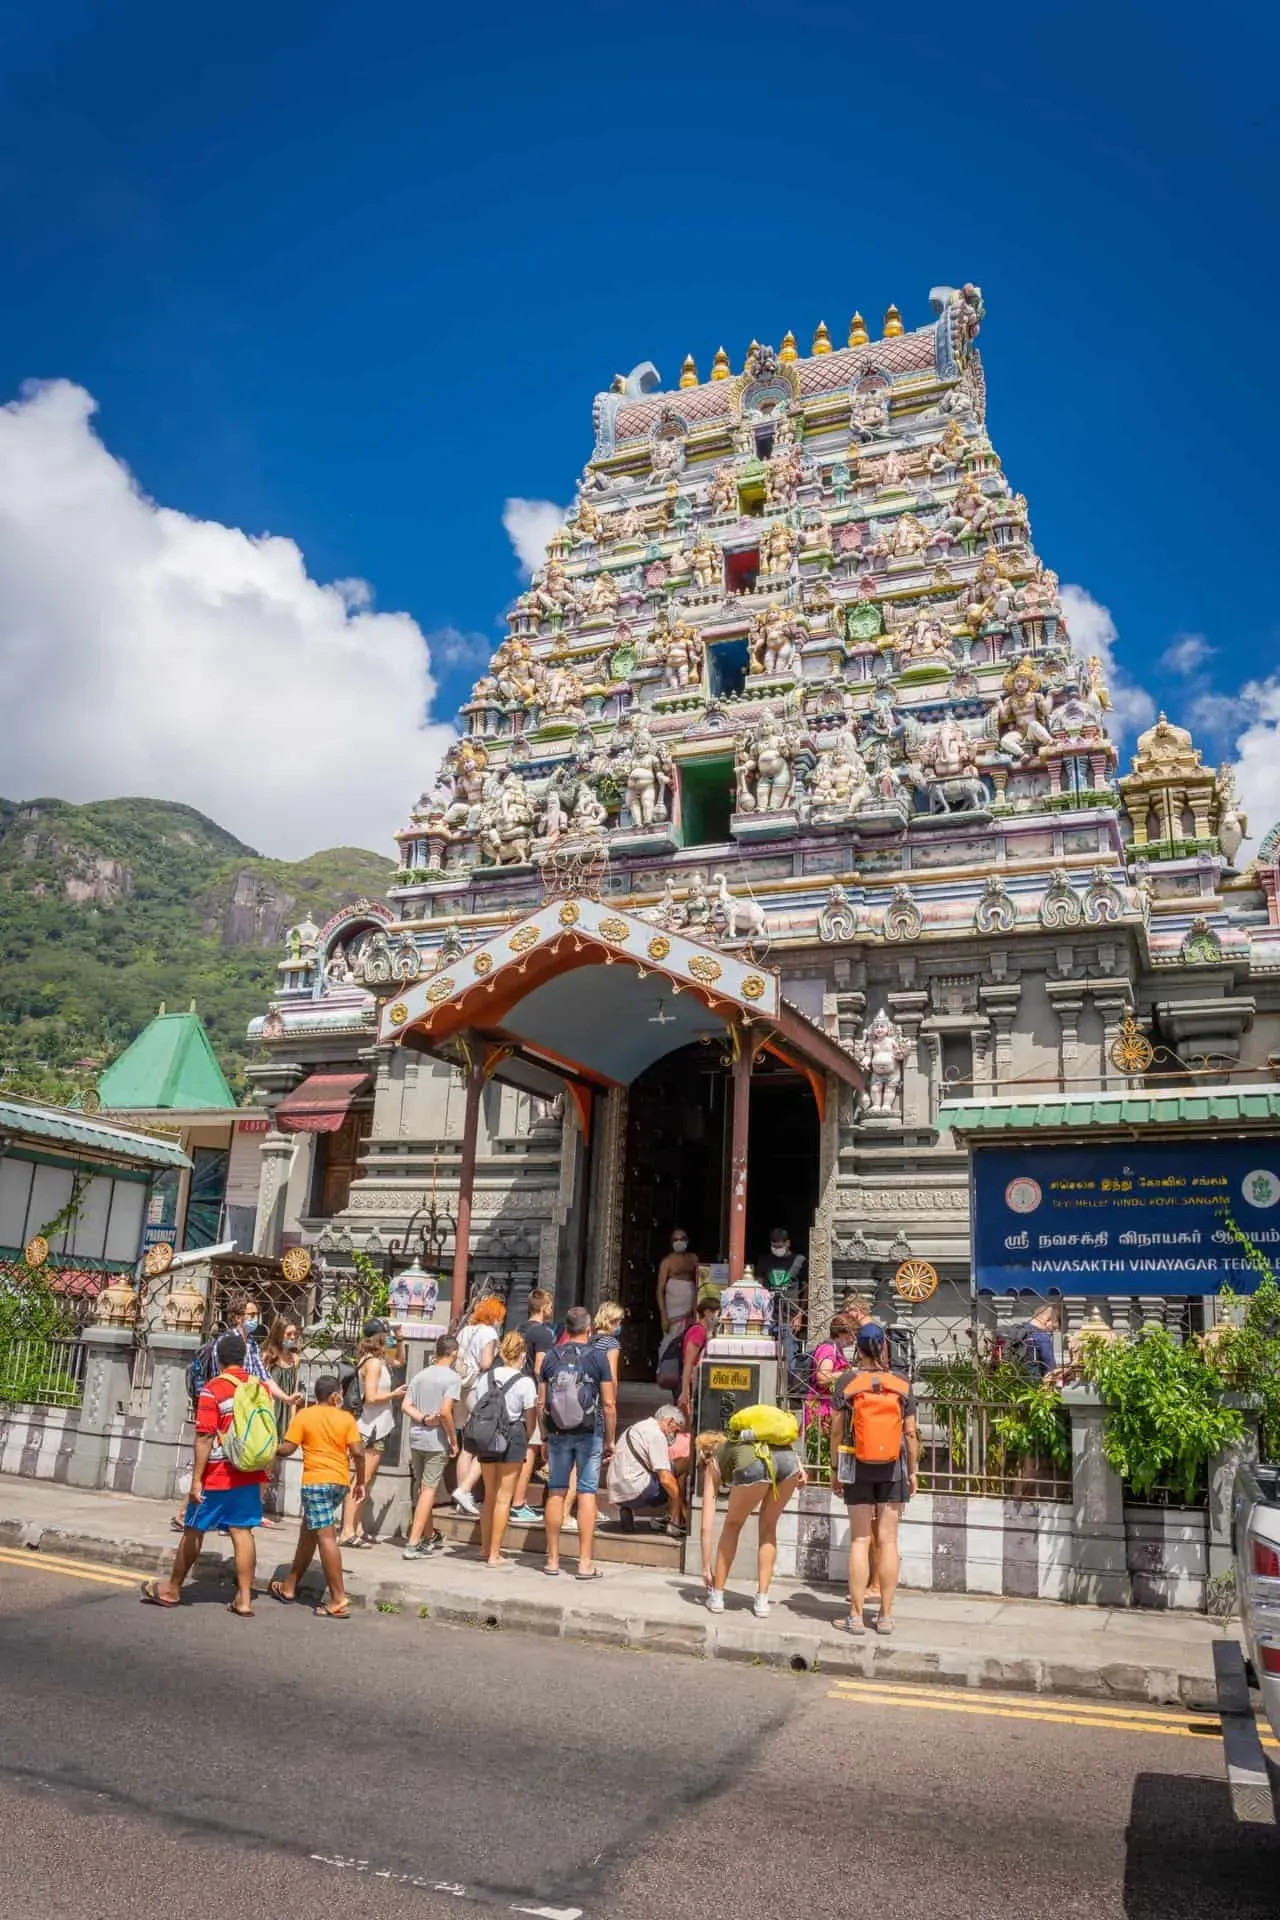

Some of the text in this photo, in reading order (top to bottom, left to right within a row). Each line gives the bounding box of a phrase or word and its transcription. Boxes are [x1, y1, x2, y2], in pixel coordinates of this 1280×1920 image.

[1031, 1259, 1125, 1273] NAVASAKTHI
[1128, 1258, 1217, 1272] VINAYAGAR
[1221, 1257, 1280, 1270] TEMLE
